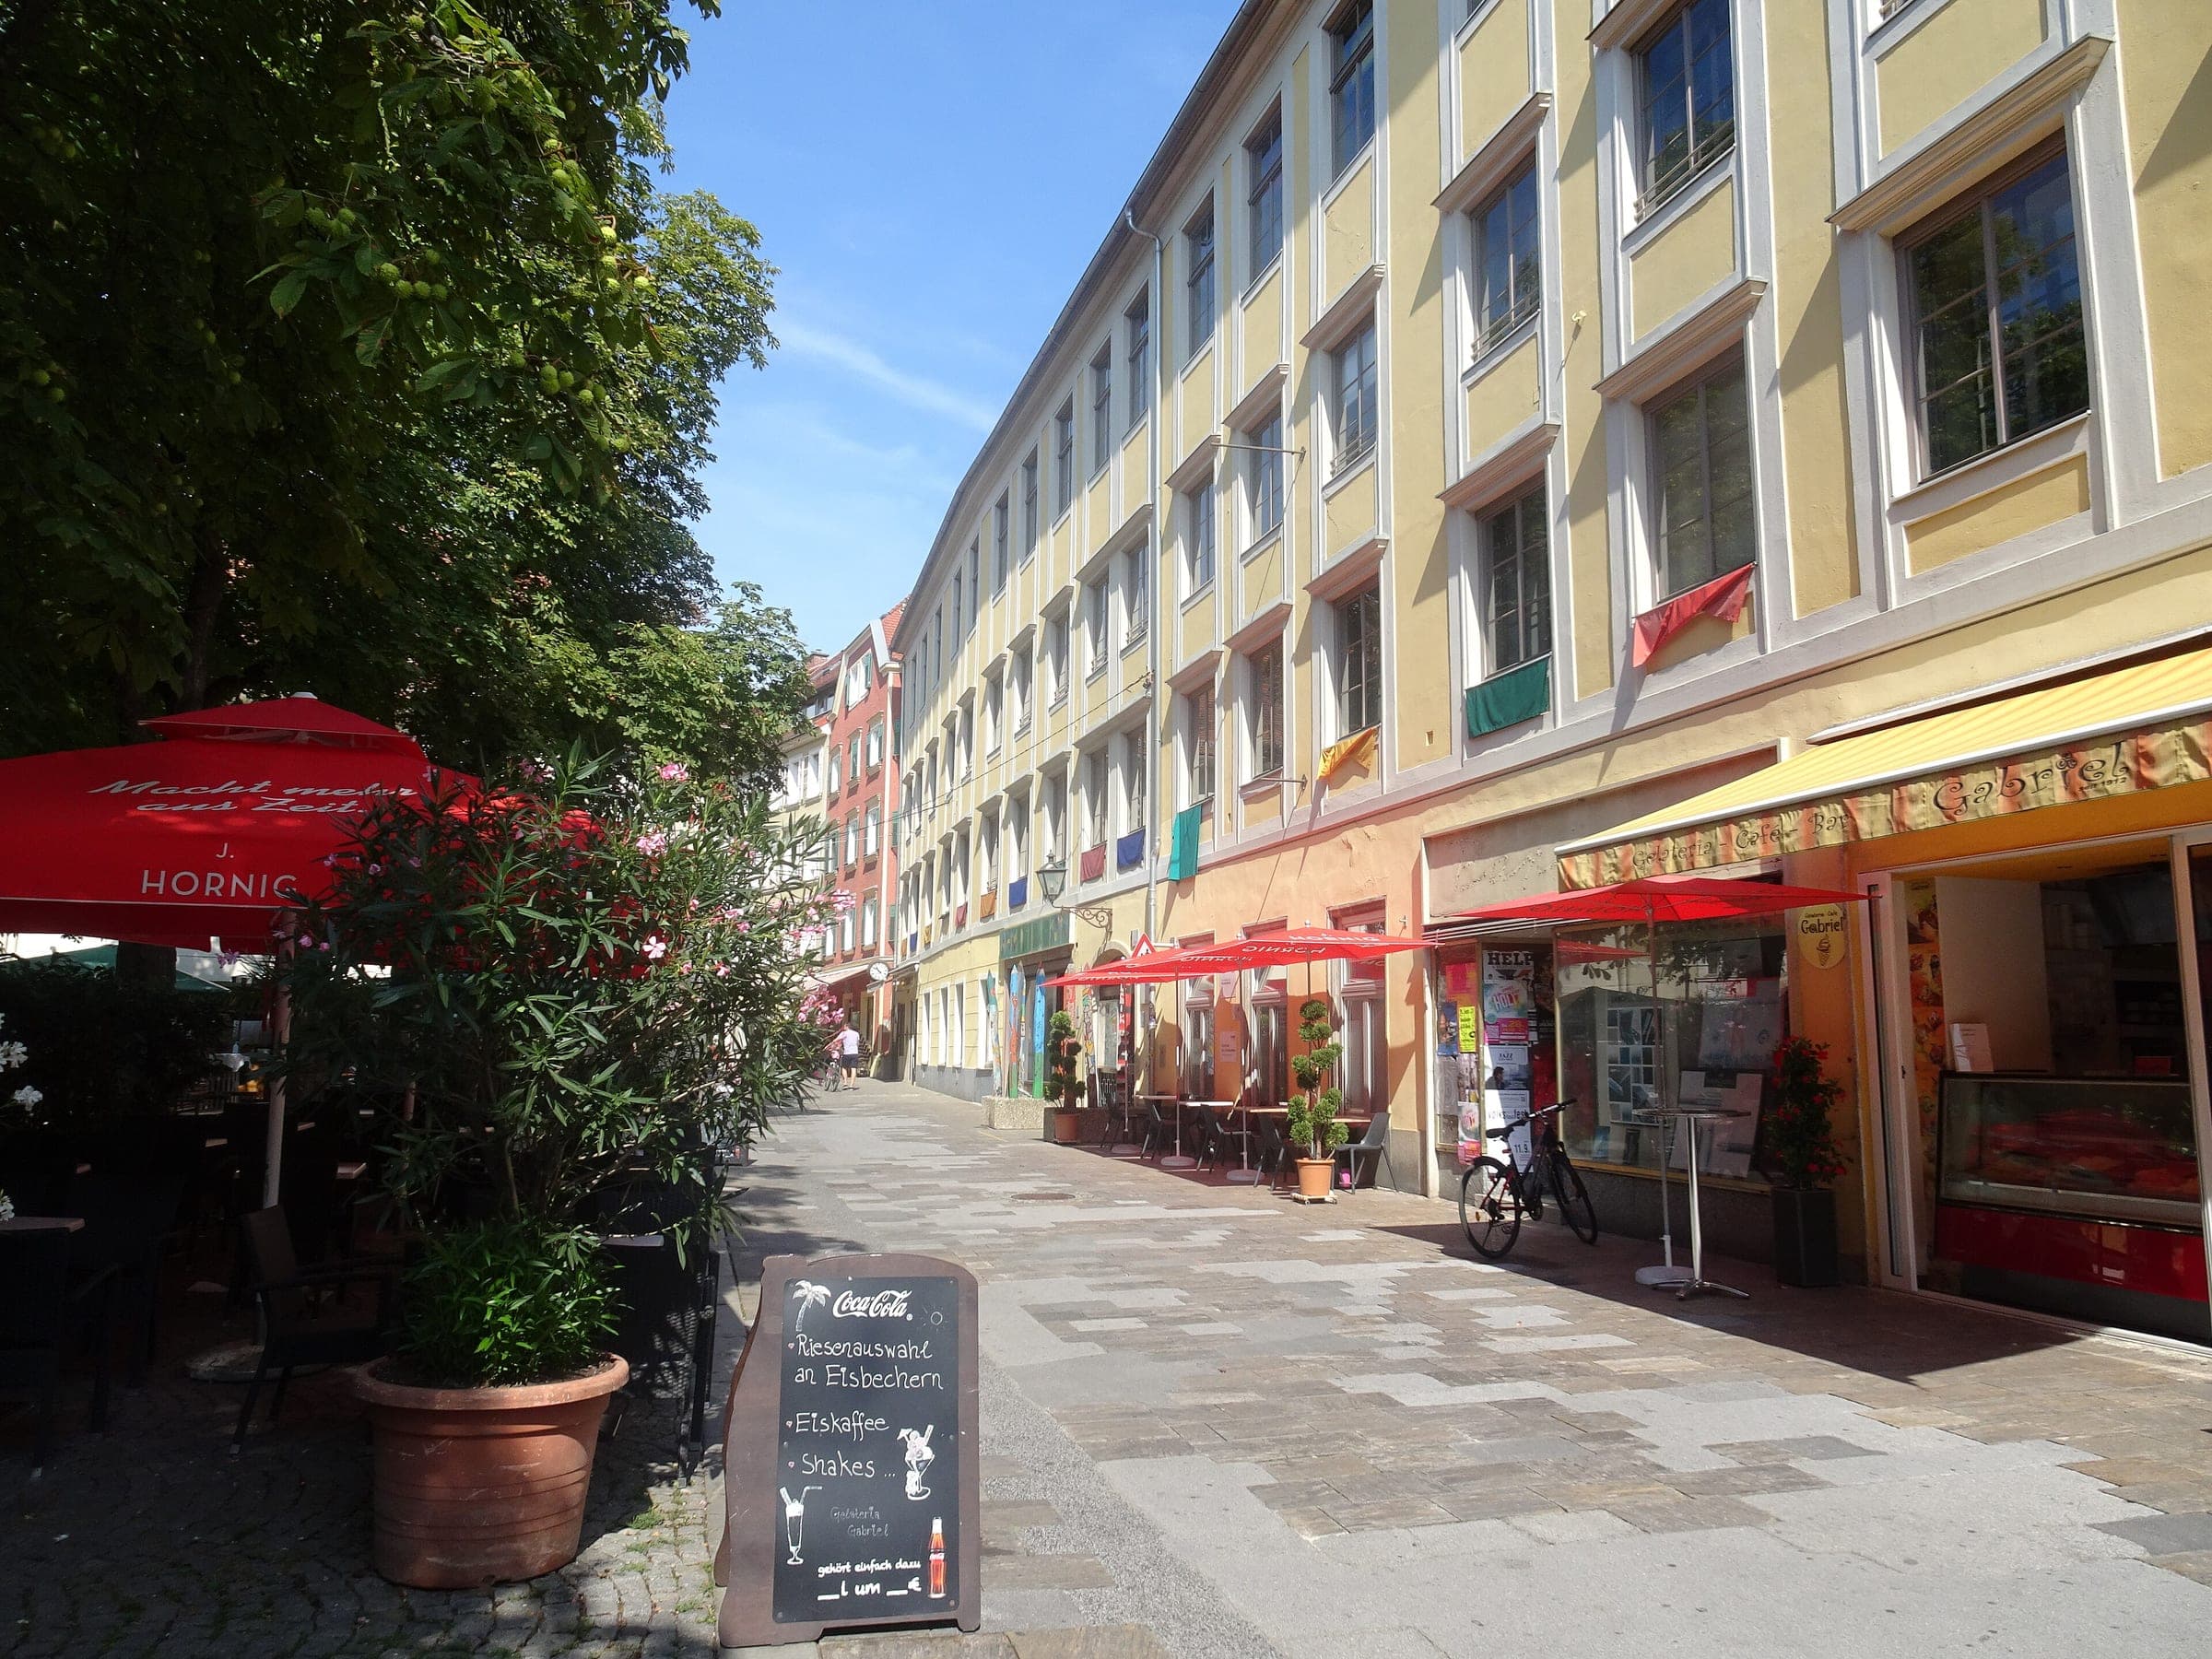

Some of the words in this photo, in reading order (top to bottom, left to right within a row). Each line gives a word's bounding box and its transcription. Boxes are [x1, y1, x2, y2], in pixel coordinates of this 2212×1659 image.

[88, 780, 272, 794] Macht
[283, 782, 418, 796] mehr
[1933, 742, 2130, 816] Gabriel
[136, 798, 238, 812] aus
[216, 842, 235, 859] J.
[1632, 836, 1712, 868] Gelateria
[1807, 811, 1850, 835] Bar
[141, 869, 298, 899] HORNIG
[1801, 916, 1844, 934] Gabriel
[795, 1334, 933, 1359] Riesenauswahl
[794, 1367, 817, 1385] an
[826, 1365, 944, 1390] Eisbechern
[795, 1411, 889, 1441] Eiskaffee
[802, 1451, 876, 1478] Shakes
[847, 1524, 890, 1537] Gabriel
[818, 1561, 852, 1578] gehört
[854, 1558, 892, 1573] einfach
[895, 1557, 922, 1570] dazu
[854, 1583, 881, 1596] um
